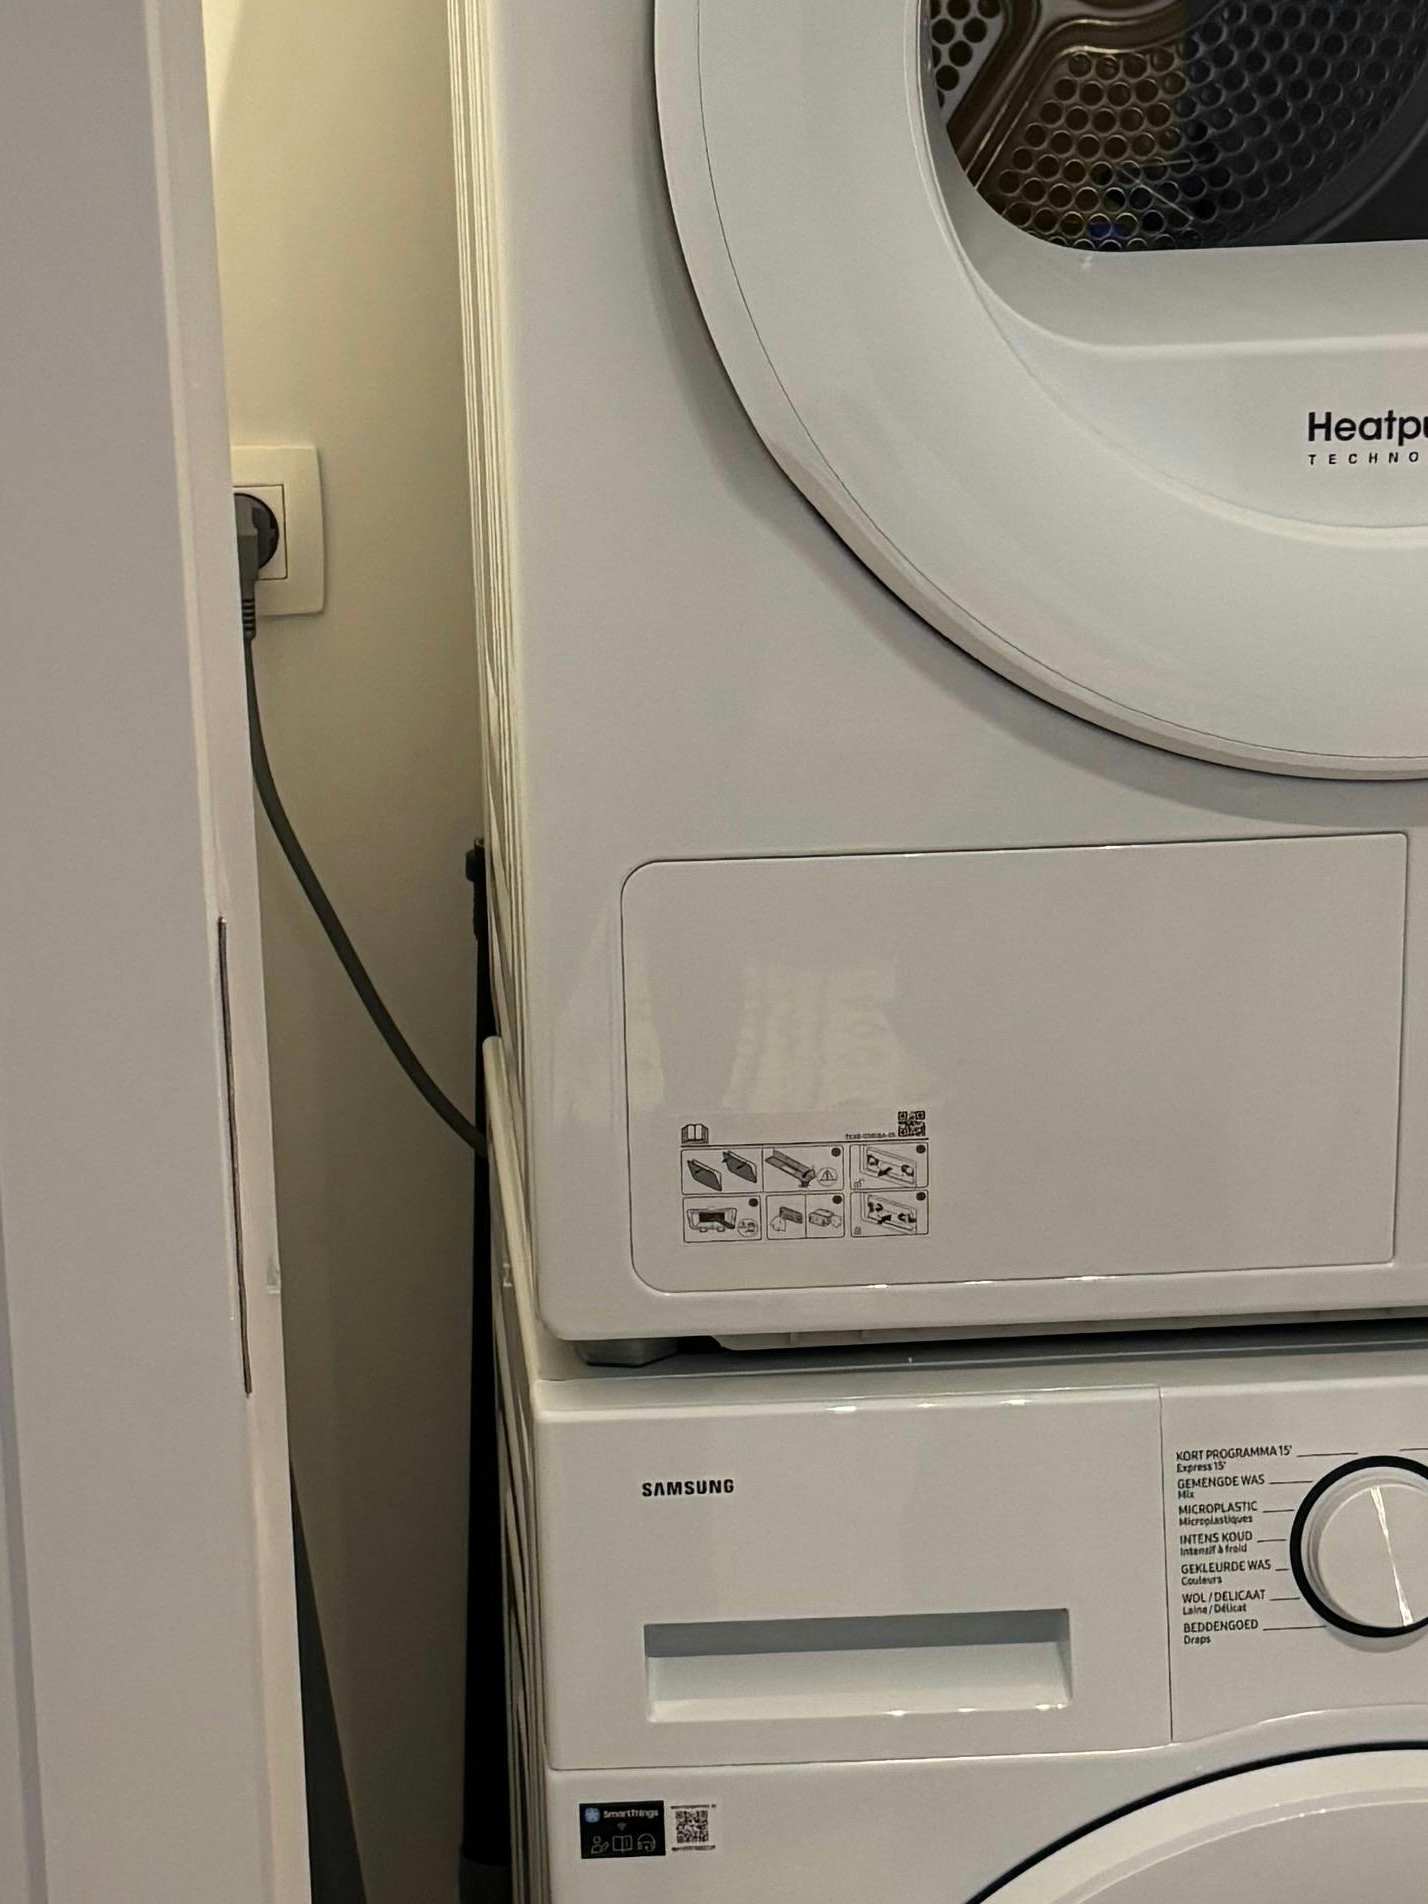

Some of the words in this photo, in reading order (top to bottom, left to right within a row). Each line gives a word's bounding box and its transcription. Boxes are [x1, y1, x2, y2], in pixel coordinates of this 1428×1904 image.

[1175, 1449, 1204, 1462] KORT
[1205, 1446, 1277, 1461] PROGRAMMA
[1176, 1462, 1212, 1474] Express
[641, 1478, 735, 1498] SAMSUNG
[1177, 1475, 1240, 1490] GEMENGDE
[1240, 1473, 1265, 1486] WAS
[1178, 1500, 1258, 1516] MICROPLASTIC
[1179, 1532, 1220, 1546] INTENS
[1221, 1530, 1254, 1543] KOUD
[1181, 1560, 1246, 1575] GEKLEURDE
[1247, 1558, 1272, 1571] WAS
[1180, 1575, 1223, 1586] Couleurs
[1181, 1592, 1207, 1604] WOL
[1213, 1588, 1266, 1602] DELICAAT
[1183, 1618, 1259, 1634] BEDDENGOED
[1183, 1634, 1211, 1646] Draps
